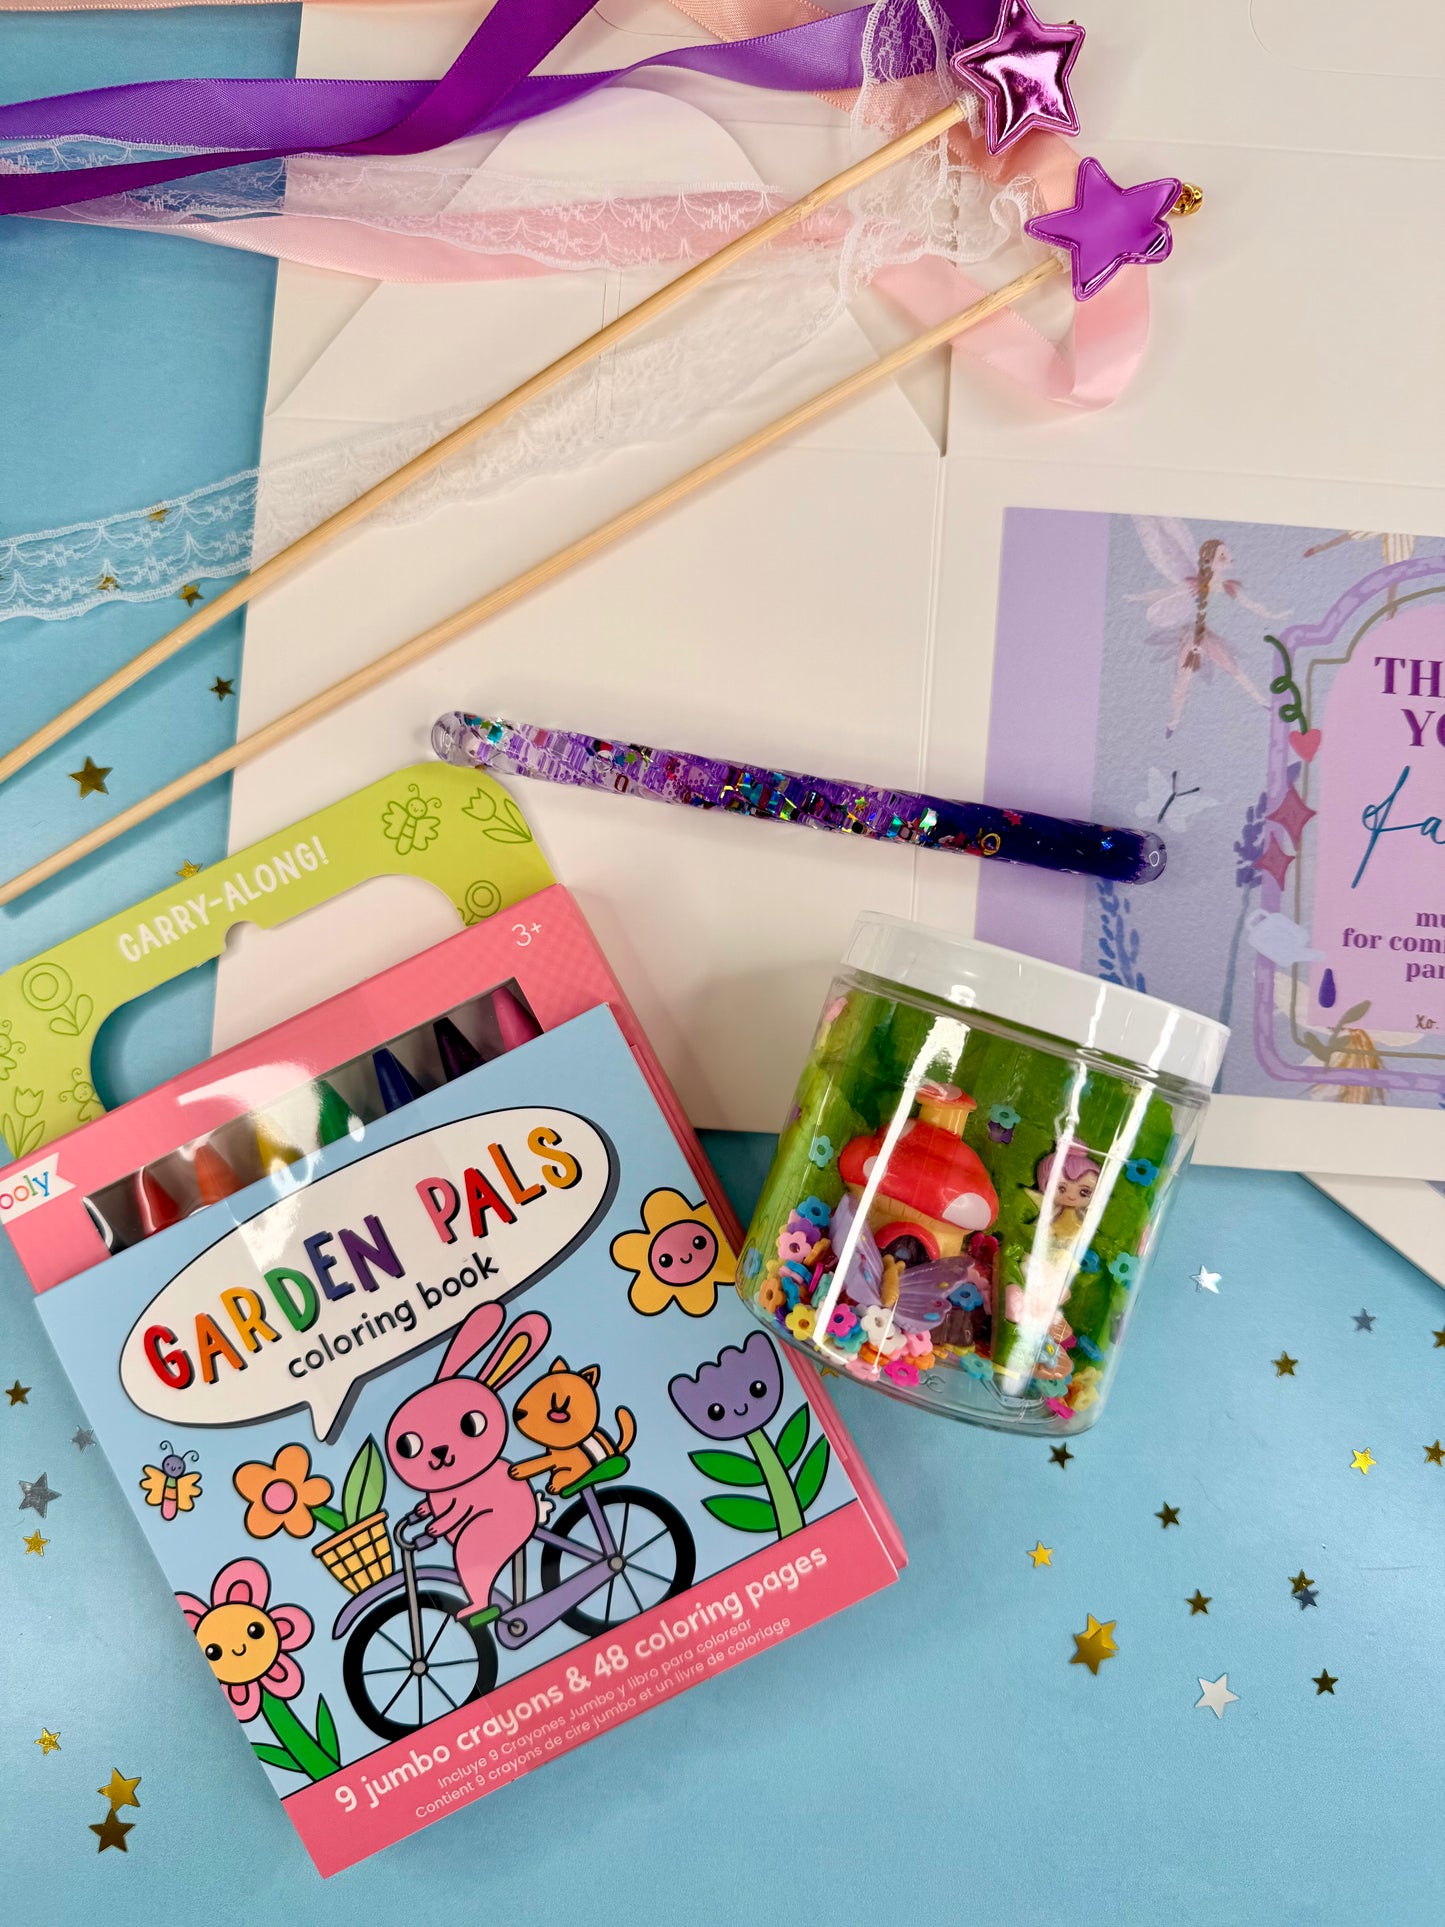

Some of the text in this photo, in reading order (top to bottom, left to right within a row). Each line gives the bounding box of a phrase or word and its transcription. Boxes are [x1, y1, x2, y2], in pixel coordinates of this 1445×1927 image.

[1374, 656, 1445, 699] TH
[118, 835, 330, 963] CARRY-ALONG!
[511, 919, 542, 948] 3+
[1342, 927, 1382, 949] for
[0, 1171, 50, 1210] ooly
[143, 1126, 582, 1390] GARDEN PALS
[288, 1251, 500, 1379] coloring book
[335, 1546, 828, 1812] 9 jumbo crayons & 48 coloring pages
[415, 1615, 792, 1819] Contient 9 crayons de cire jumbo et un livre de coloriage
[438, 1617, 752, 1788] Incluye 9 Crayones Jumbo y libro para colorear
